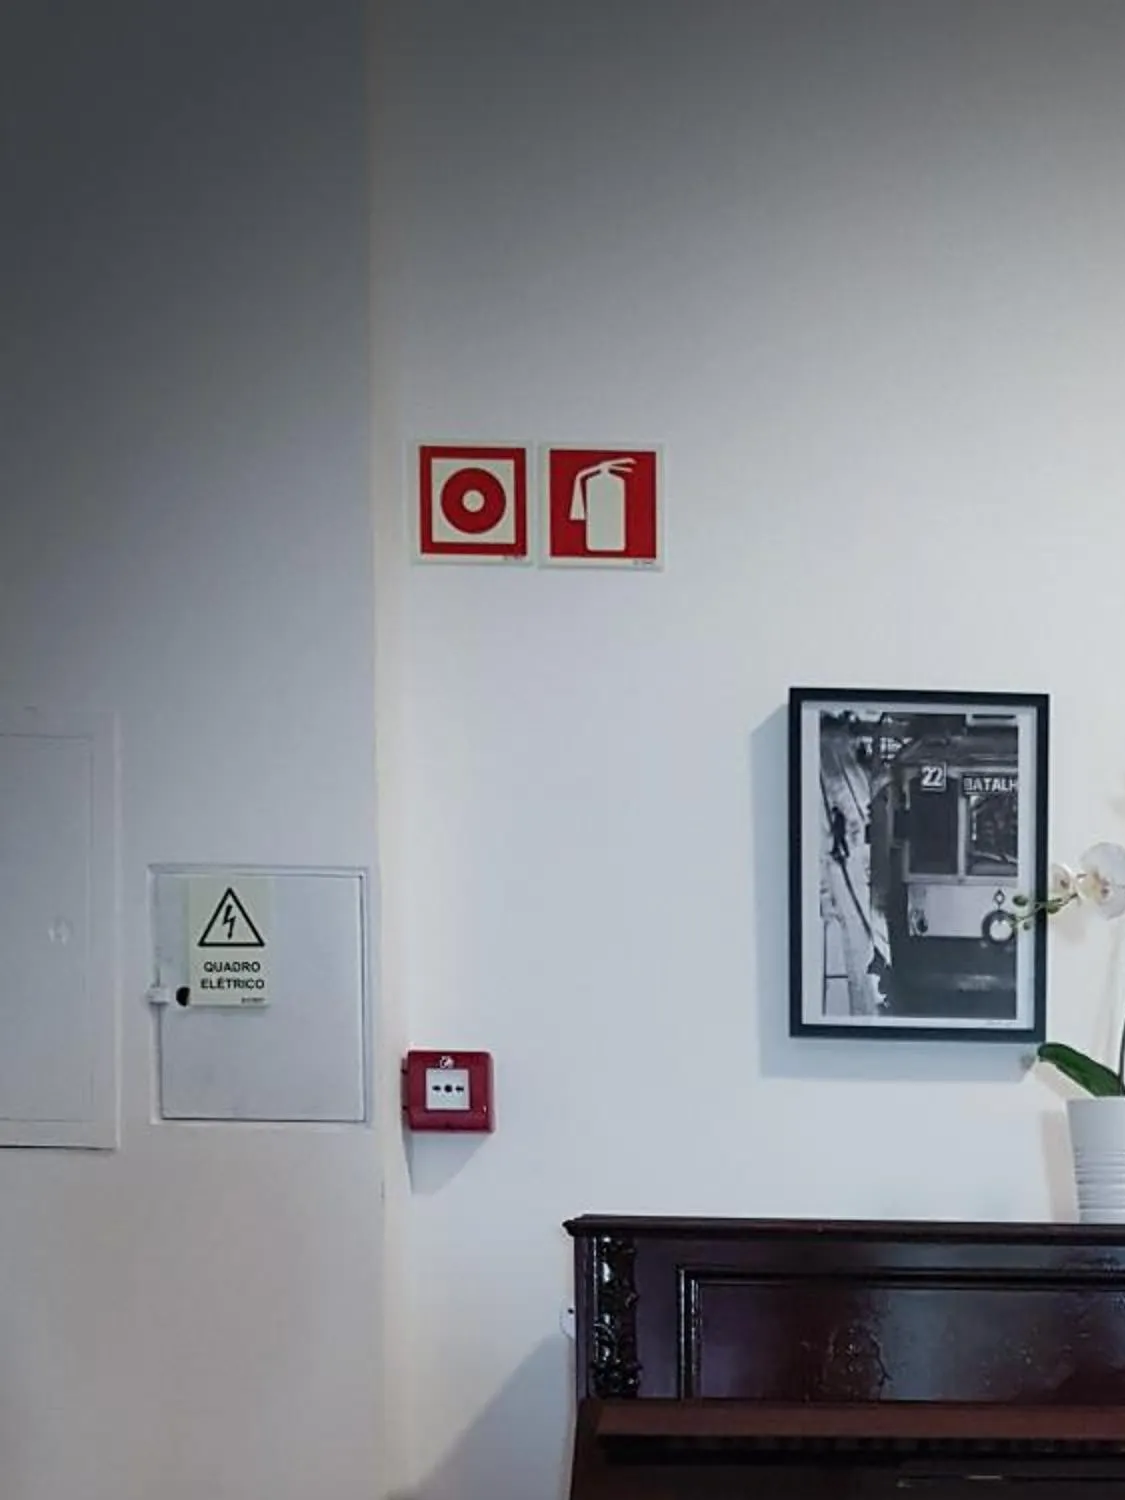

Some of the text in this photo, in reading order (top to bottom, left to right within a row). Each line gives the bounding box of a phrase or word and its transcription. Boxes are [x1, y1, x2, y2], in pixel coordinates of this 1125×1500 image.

[921, 766, 943, 787] 22
[203, 961, 261, 973] QUADRO
[200, 977, 265, 990] ELÉTRICO
